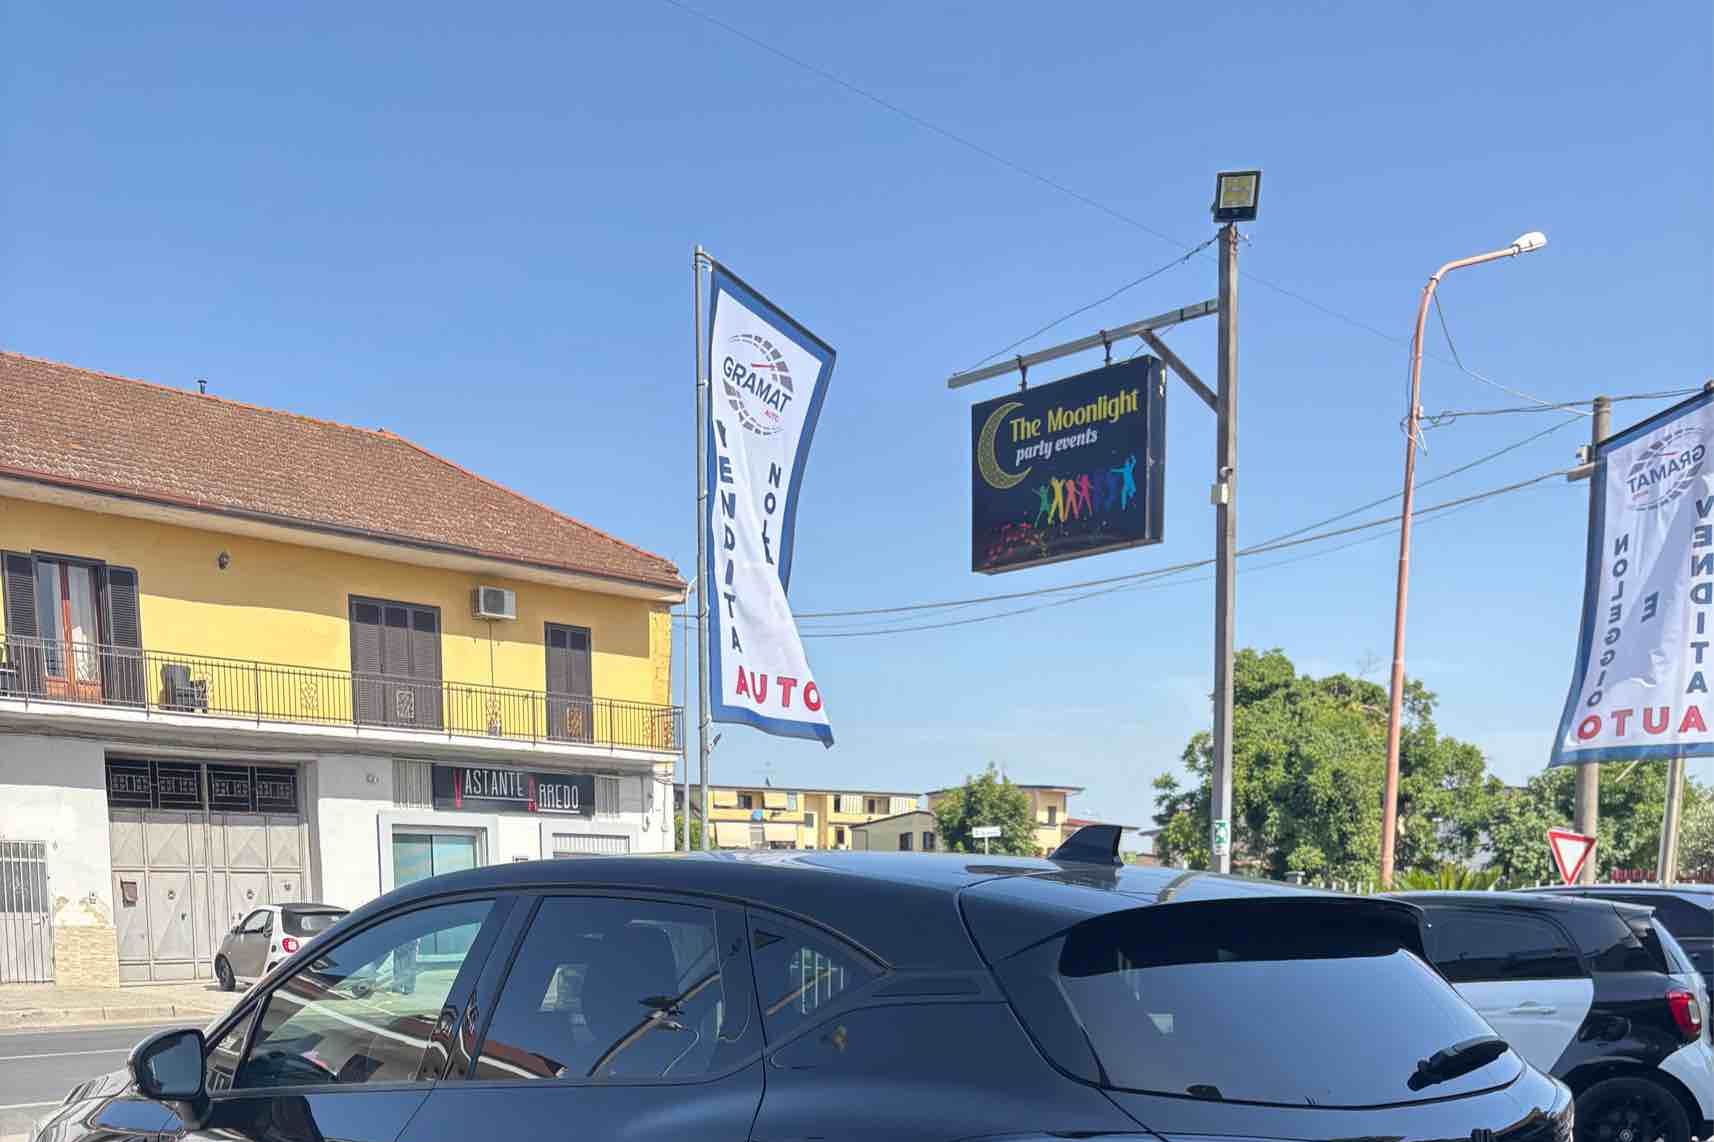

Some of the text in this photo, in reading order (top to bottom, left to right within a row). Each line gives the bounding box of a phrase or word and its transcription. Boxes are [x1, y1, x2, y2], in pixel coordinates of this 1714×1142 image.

[723, 356, 792, 412] GRAMAT
[1009, 388, 1139, 443] The Moonlight
[1015, 427, 1098, 466] party events
[736, 665, 821, 711] AUTO
[453, 767, 579, 811] VASTANTE ARREDO
